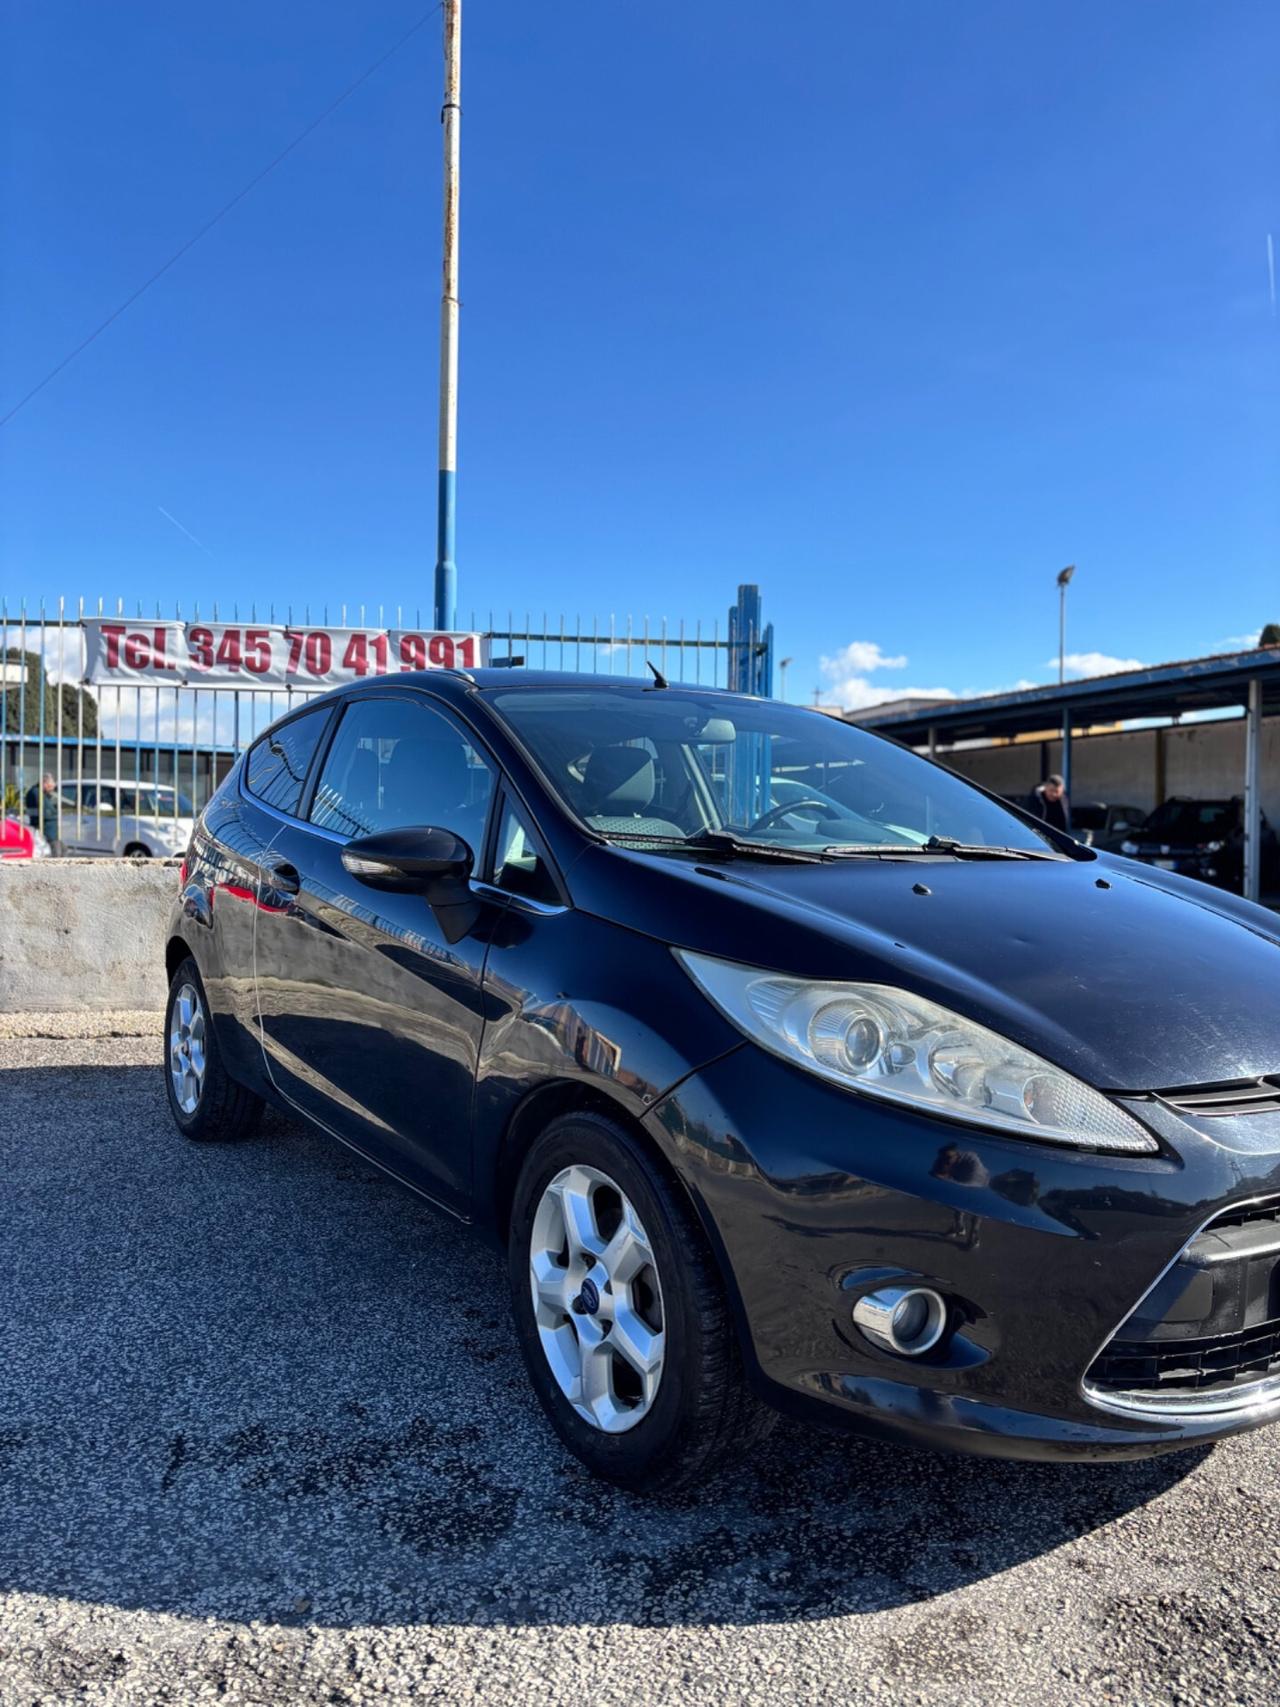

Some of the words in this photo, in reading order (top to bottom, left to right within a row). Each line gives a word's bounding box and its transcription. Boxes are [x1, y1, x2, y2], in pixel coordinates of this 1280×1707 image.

[100, 625, 175, 669] Tel.
[188, 628, 271, 673] 345
[284, 631, 332, 676] 70
[341, 633, 388, 676] 41
[400, 634, 475, 671] 991
